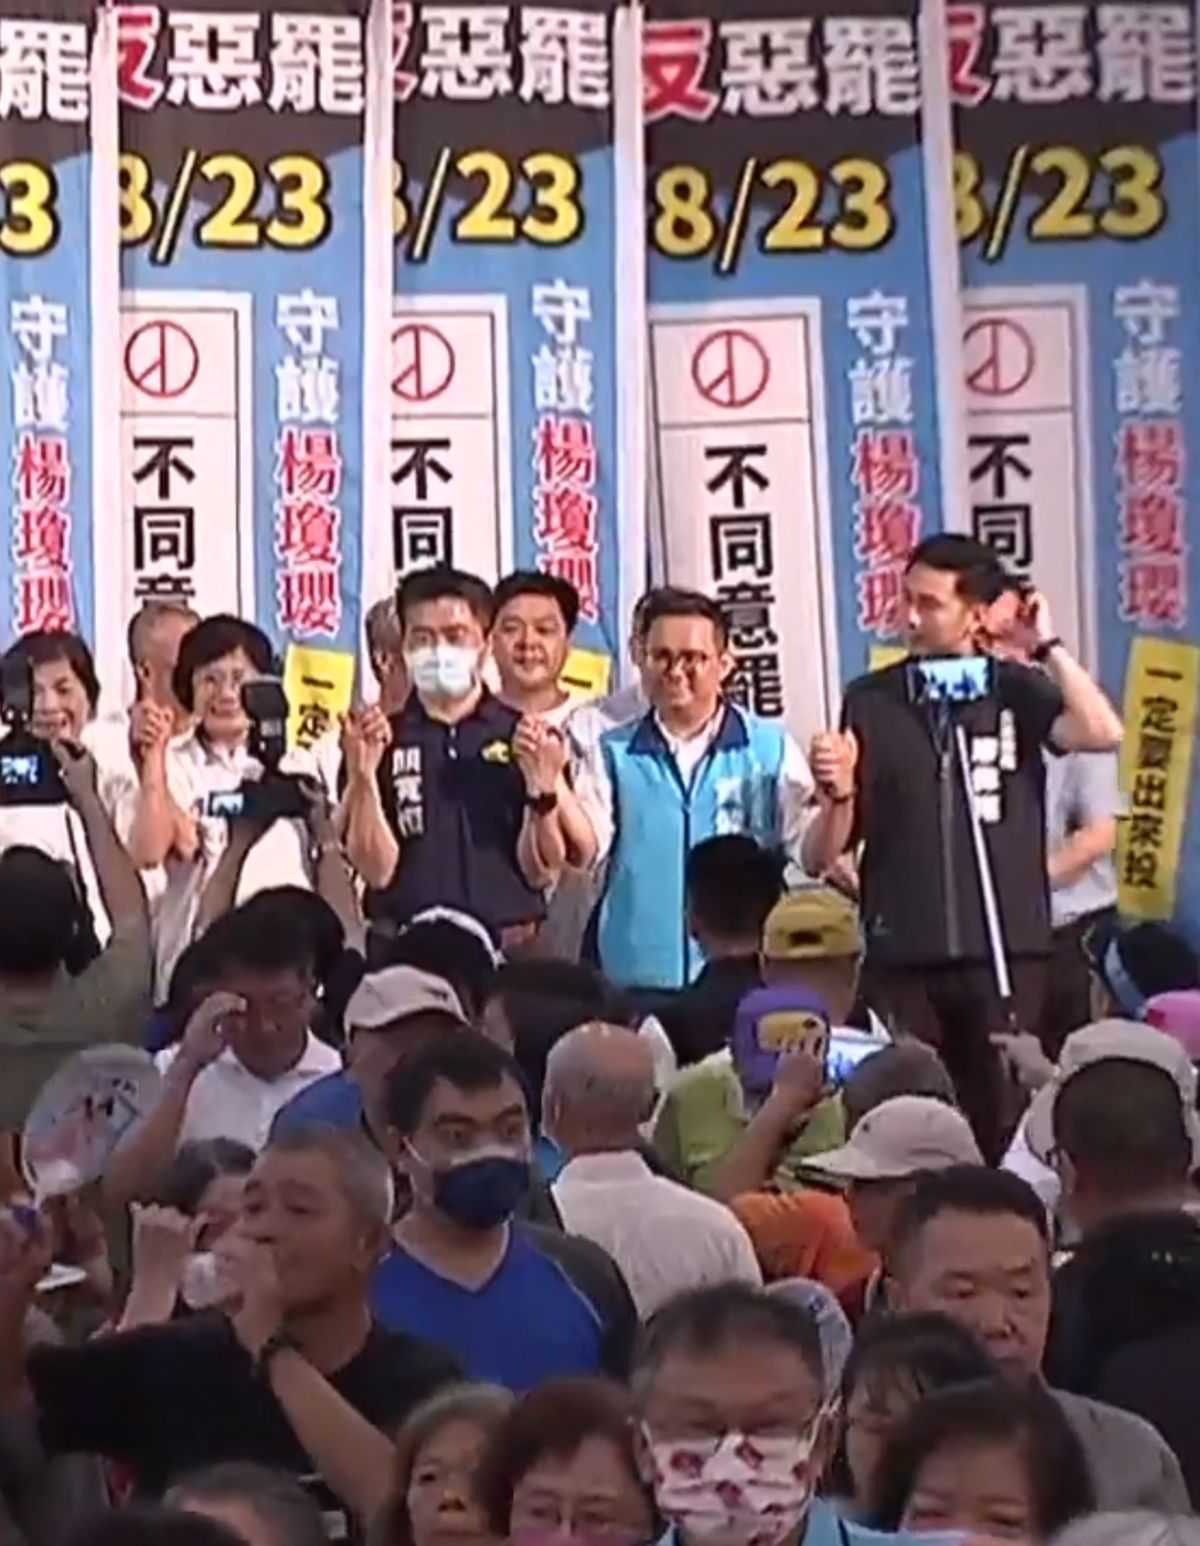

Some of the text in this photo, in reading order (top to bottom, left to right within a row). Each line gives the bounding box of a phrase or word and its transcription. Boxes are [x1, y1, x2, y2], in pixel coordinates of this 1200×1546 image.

[392, 5, 610, 107] 惡罷
[642, 15, 921, 121] 反惡罷
[118, 147, 329, 264] 8/23
[393, 145, 584, 263] /23
[650, 155, 892, 275] 8/23
[275, 289, 343, 636] 守護楊瓊瓔
